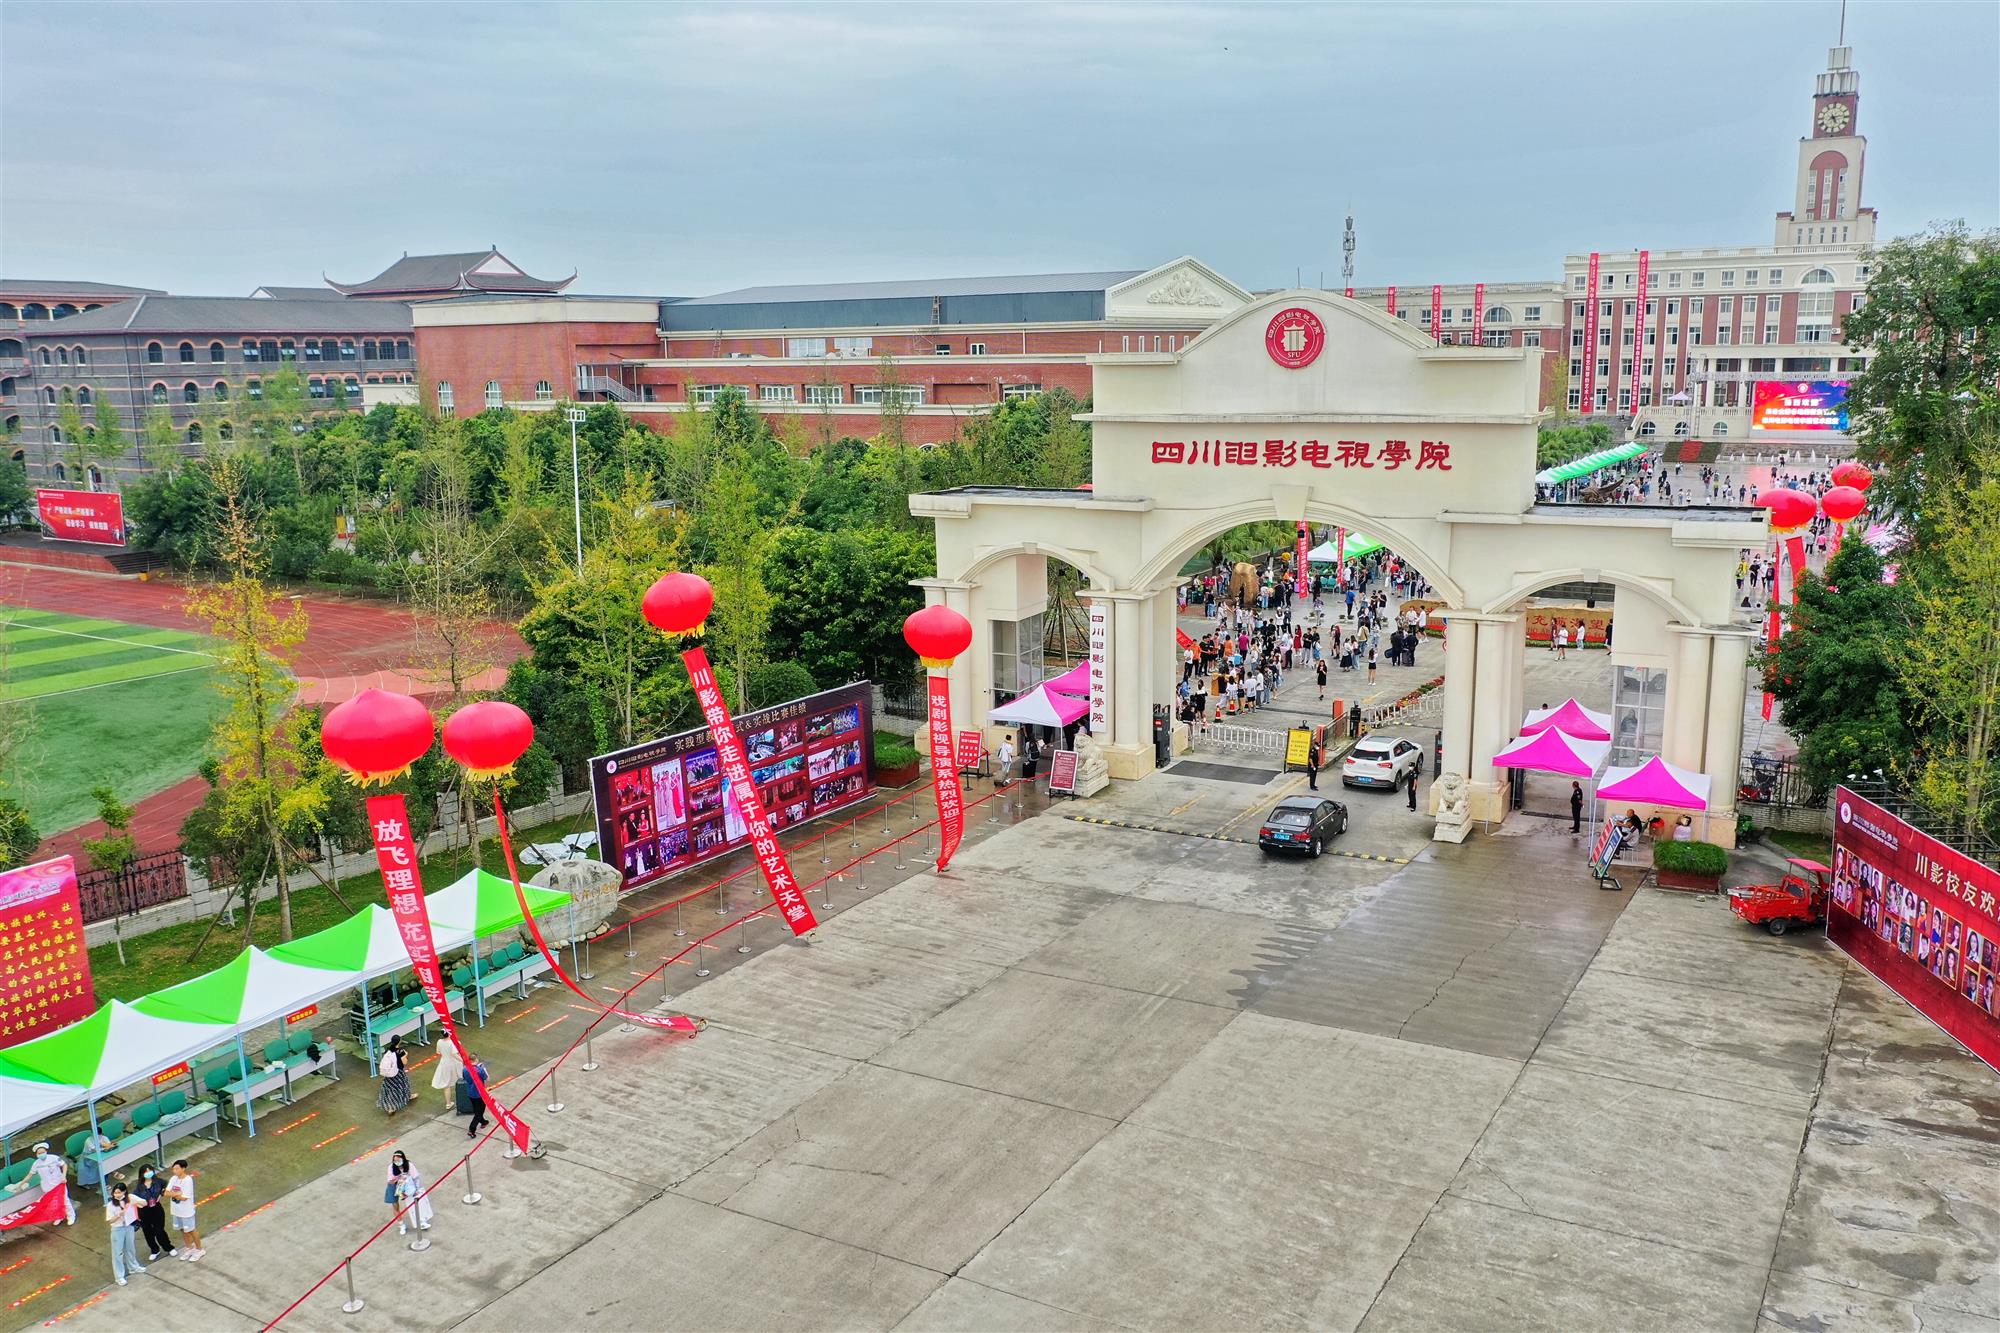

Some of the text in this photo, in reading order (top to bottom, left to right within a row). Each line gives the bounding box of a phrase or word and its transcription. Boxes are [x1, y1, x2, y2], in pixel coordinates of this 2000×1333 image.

[693, 667, 808, 922] 川影带你走进属于你的艺术天堂
[374, 818, 421, 915] 放飞理想
[1915, 852, 2000, 922] 川影校友欢
